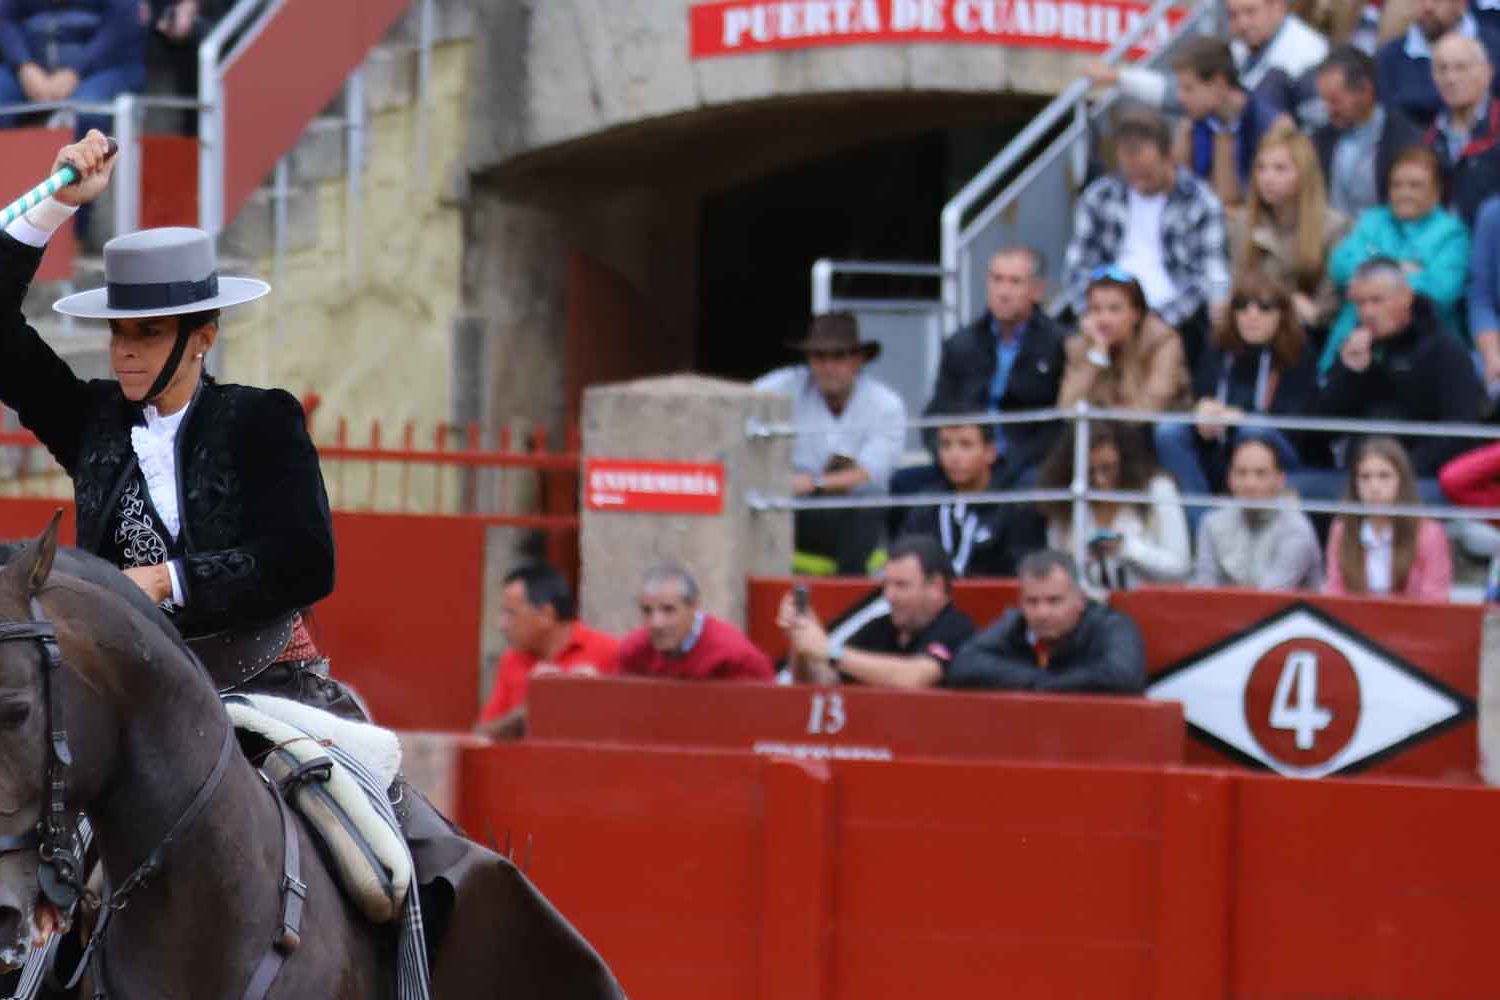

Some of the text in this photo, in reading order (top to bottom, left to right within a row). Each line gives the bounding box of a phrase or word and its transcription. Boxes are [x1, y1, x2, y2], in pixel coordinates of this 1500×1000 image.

[723, 0, 880, 47] PUERTA
[891, 0, 946, 32] DE
[807, 692, 846, 734] 13
[1268, 650, 1333, 751] 4
